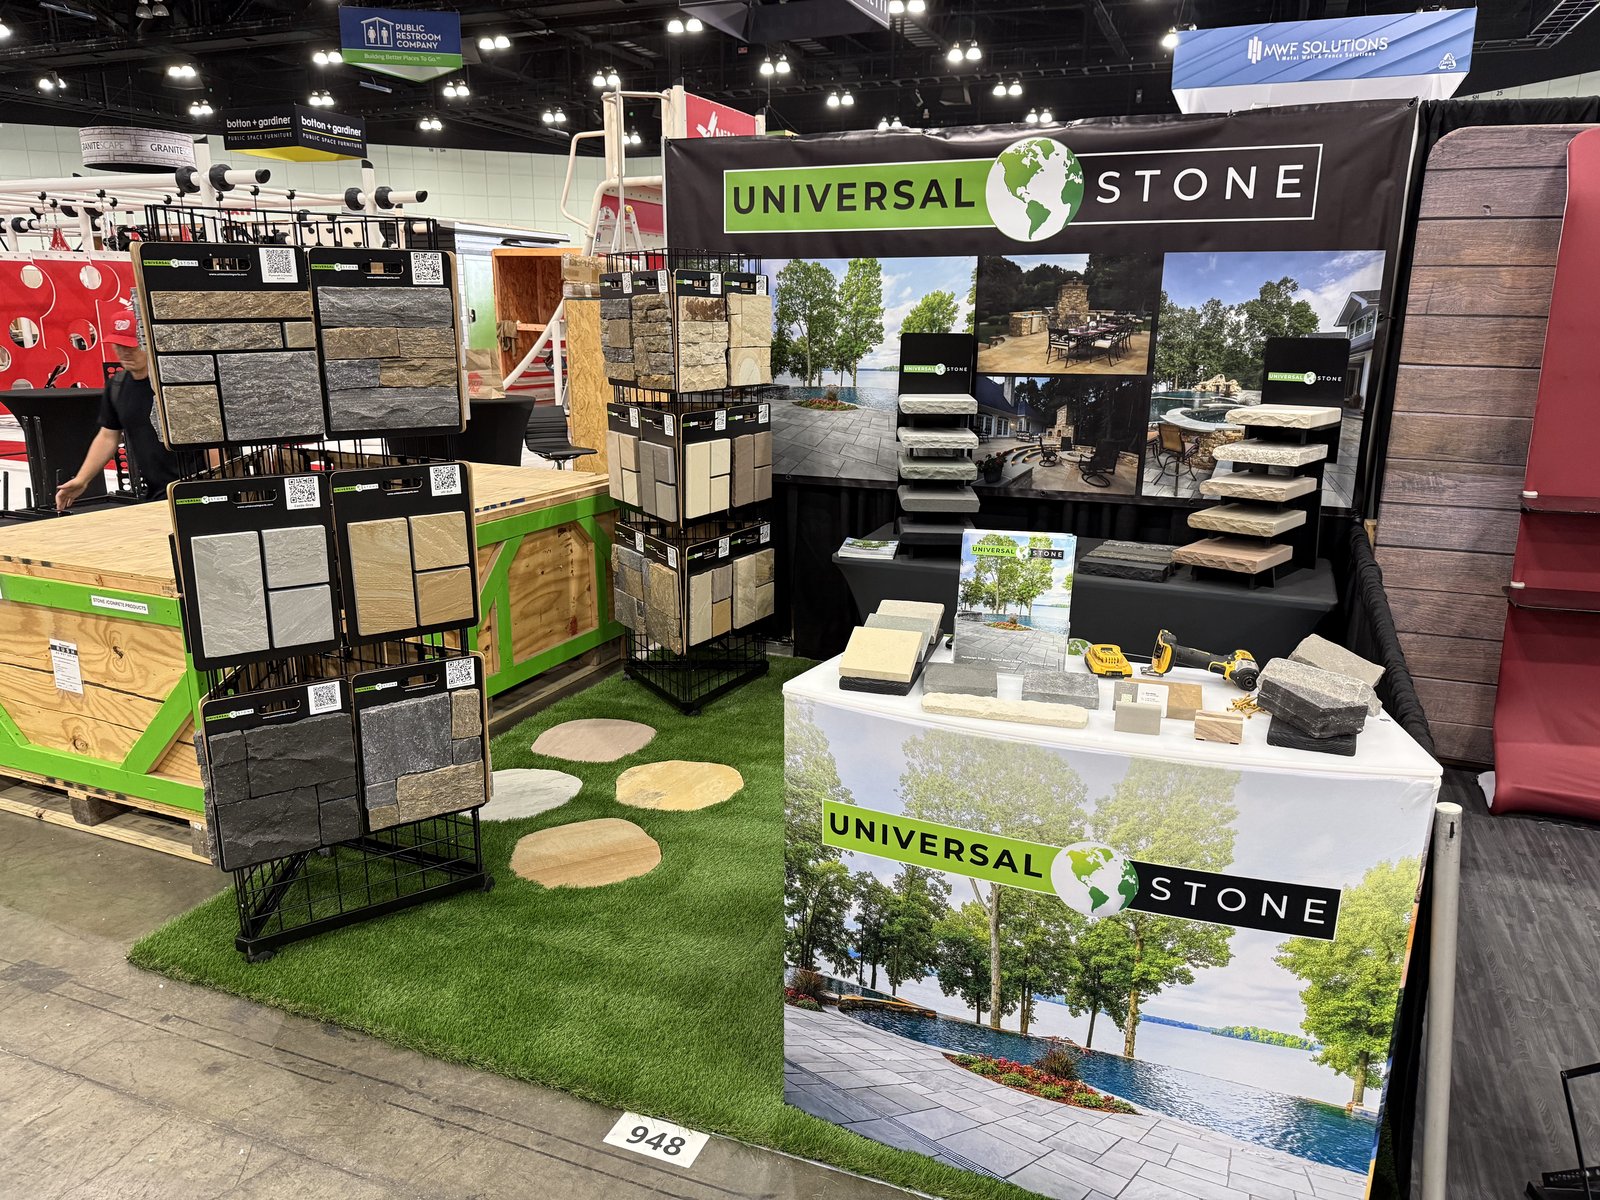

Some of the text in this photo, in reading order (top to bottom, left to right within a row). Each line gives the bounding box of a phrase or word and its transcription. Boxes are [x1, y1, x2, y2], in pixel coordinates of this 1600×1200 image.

[395, 23, 425, 32] PUBLIC
[396, 32, 441, 41] RESTROOM
[396, 40, 438, 49] COMPANY
[1263, 37, 1389, 61] MWF SOLUTIONS
[364, 53, 385, 61] Building
[226, 118, 251, 128] botton
[258, 116, 291, 128] gardiner
[301, 116, 326, 130] botton
[332, 125, 361, 137] gardiner
[302, 132, 362, 149] PUBLIC SPACE FURNITURE
[733, 164, 1304, 216] UNIVERSAL STONE
[972, 546, 1063, 558] UNIVERSAL STONE
[125, 602, 147, 611] PRODUCTS
[830, 812, 1327, 924] UNIVERSAL STONE
[626, 1126, 685, 1155] 948
